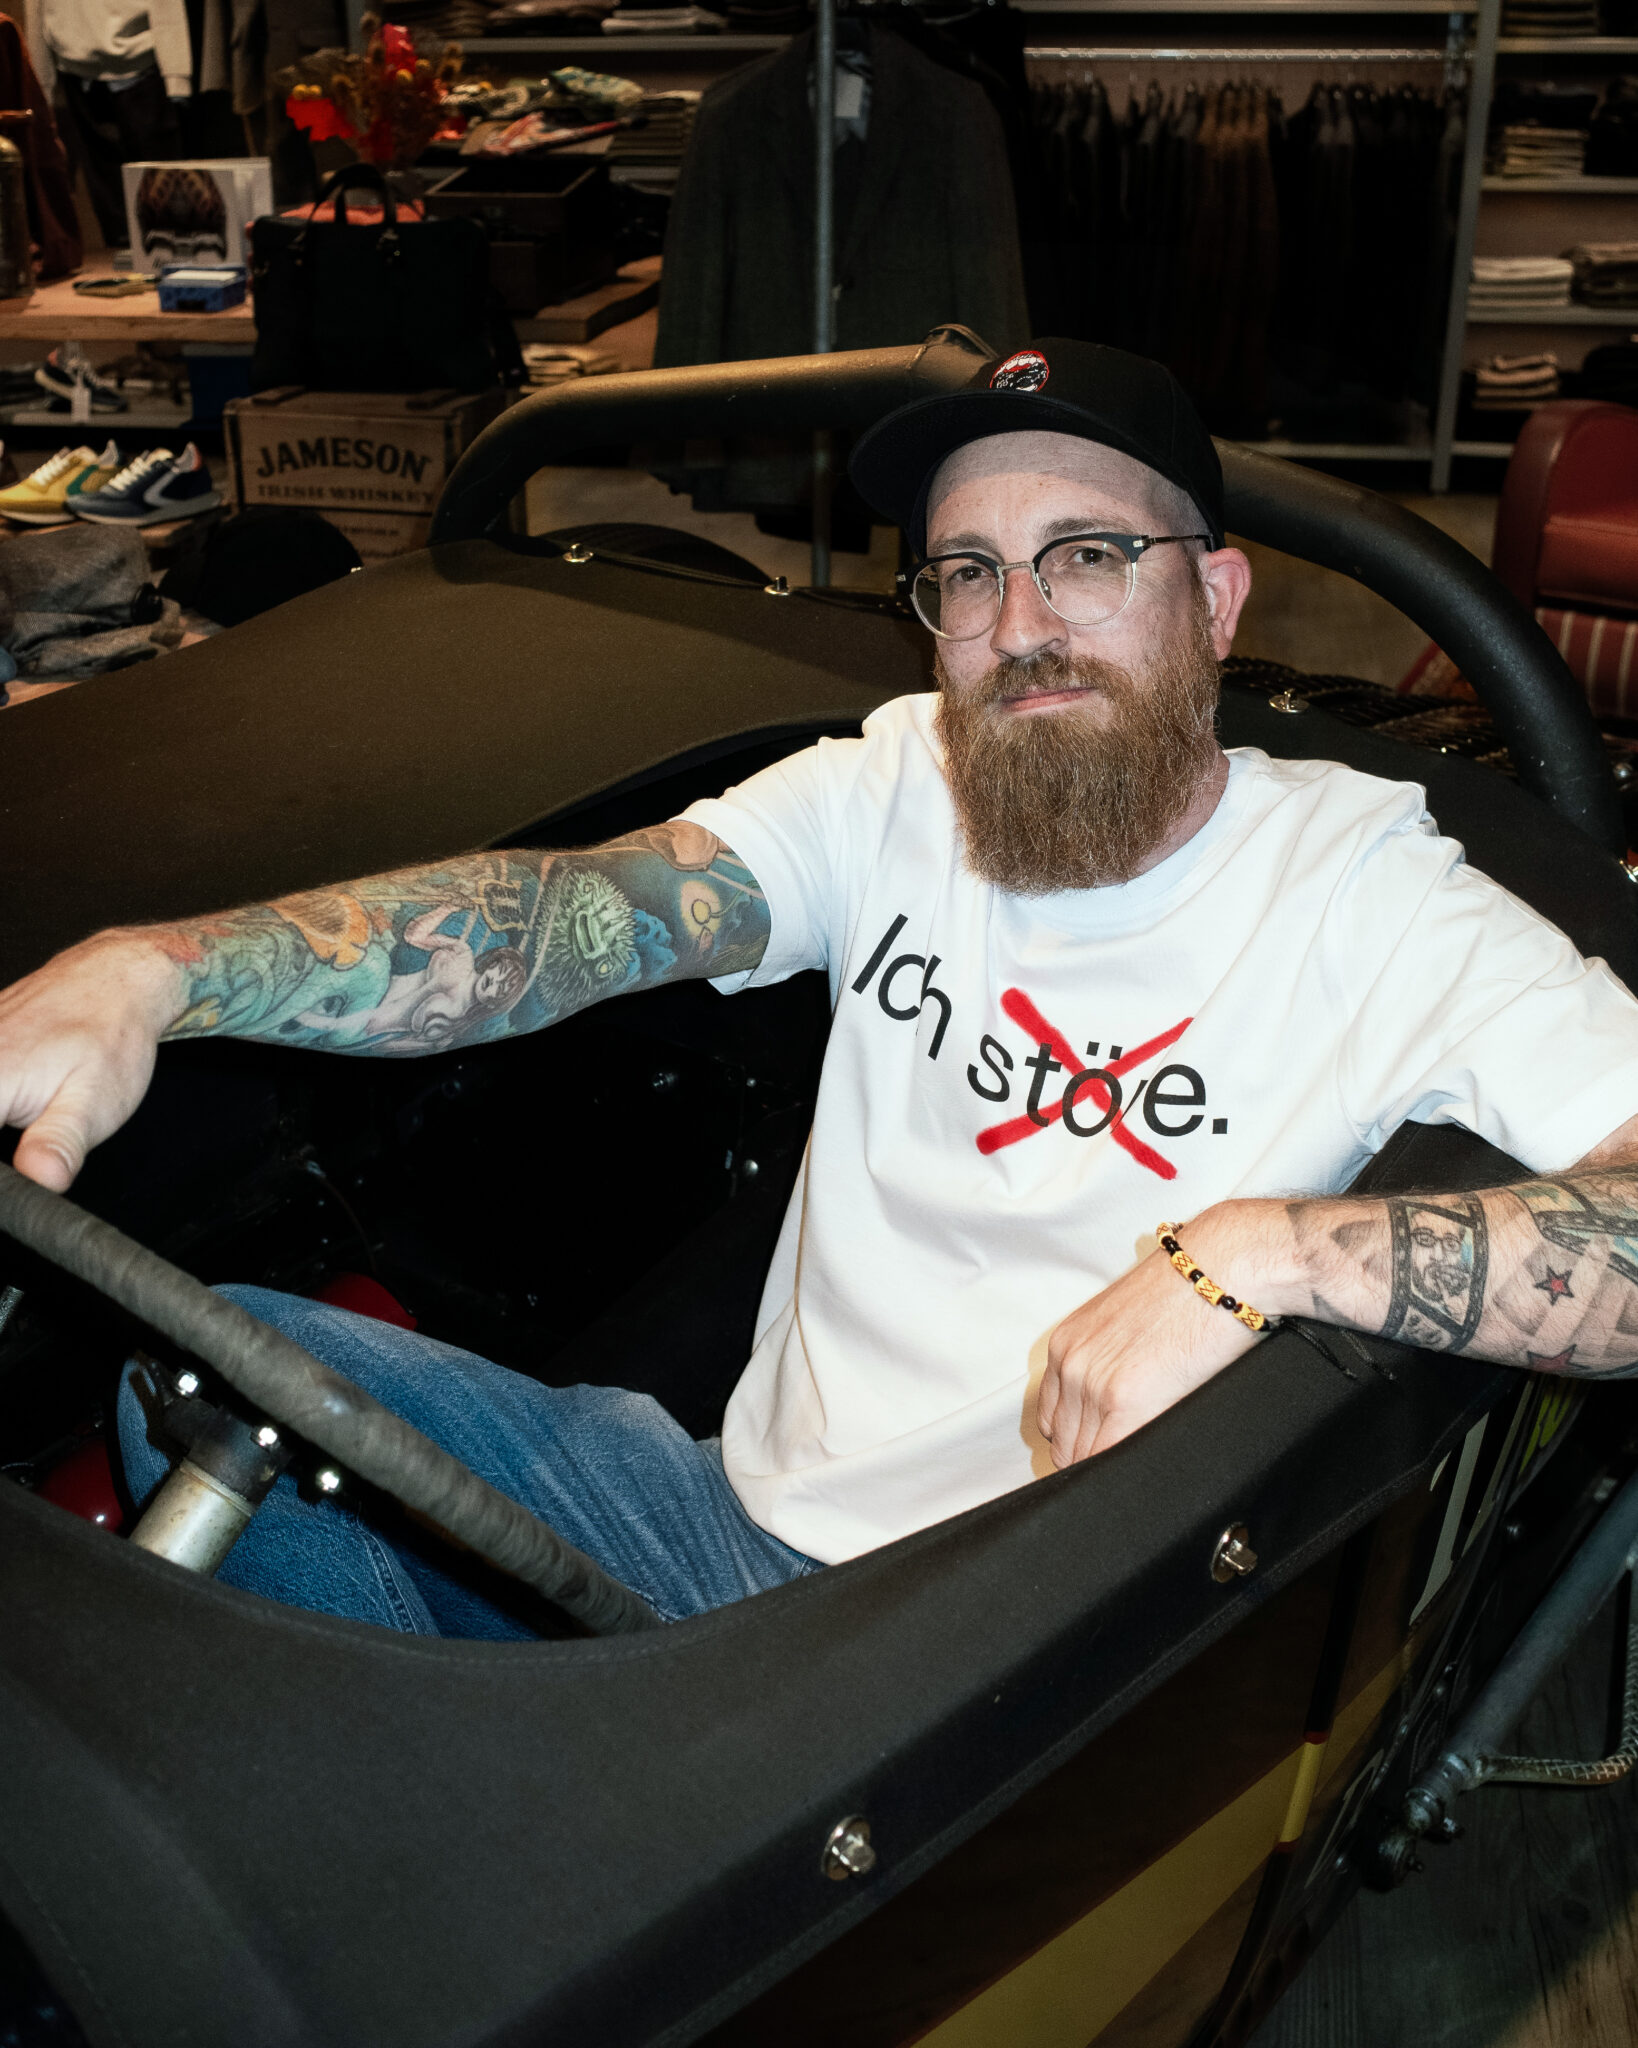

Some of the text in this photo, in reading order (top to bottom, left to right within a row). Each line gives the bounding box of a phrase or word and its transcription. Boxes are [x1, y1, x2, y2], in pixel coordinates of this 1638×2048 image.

[257, 437, 430, 482] JAMESON
[258, 484, 433, 504] IRISH WHISKEY
[851, 913, 954, 1061] Ich
